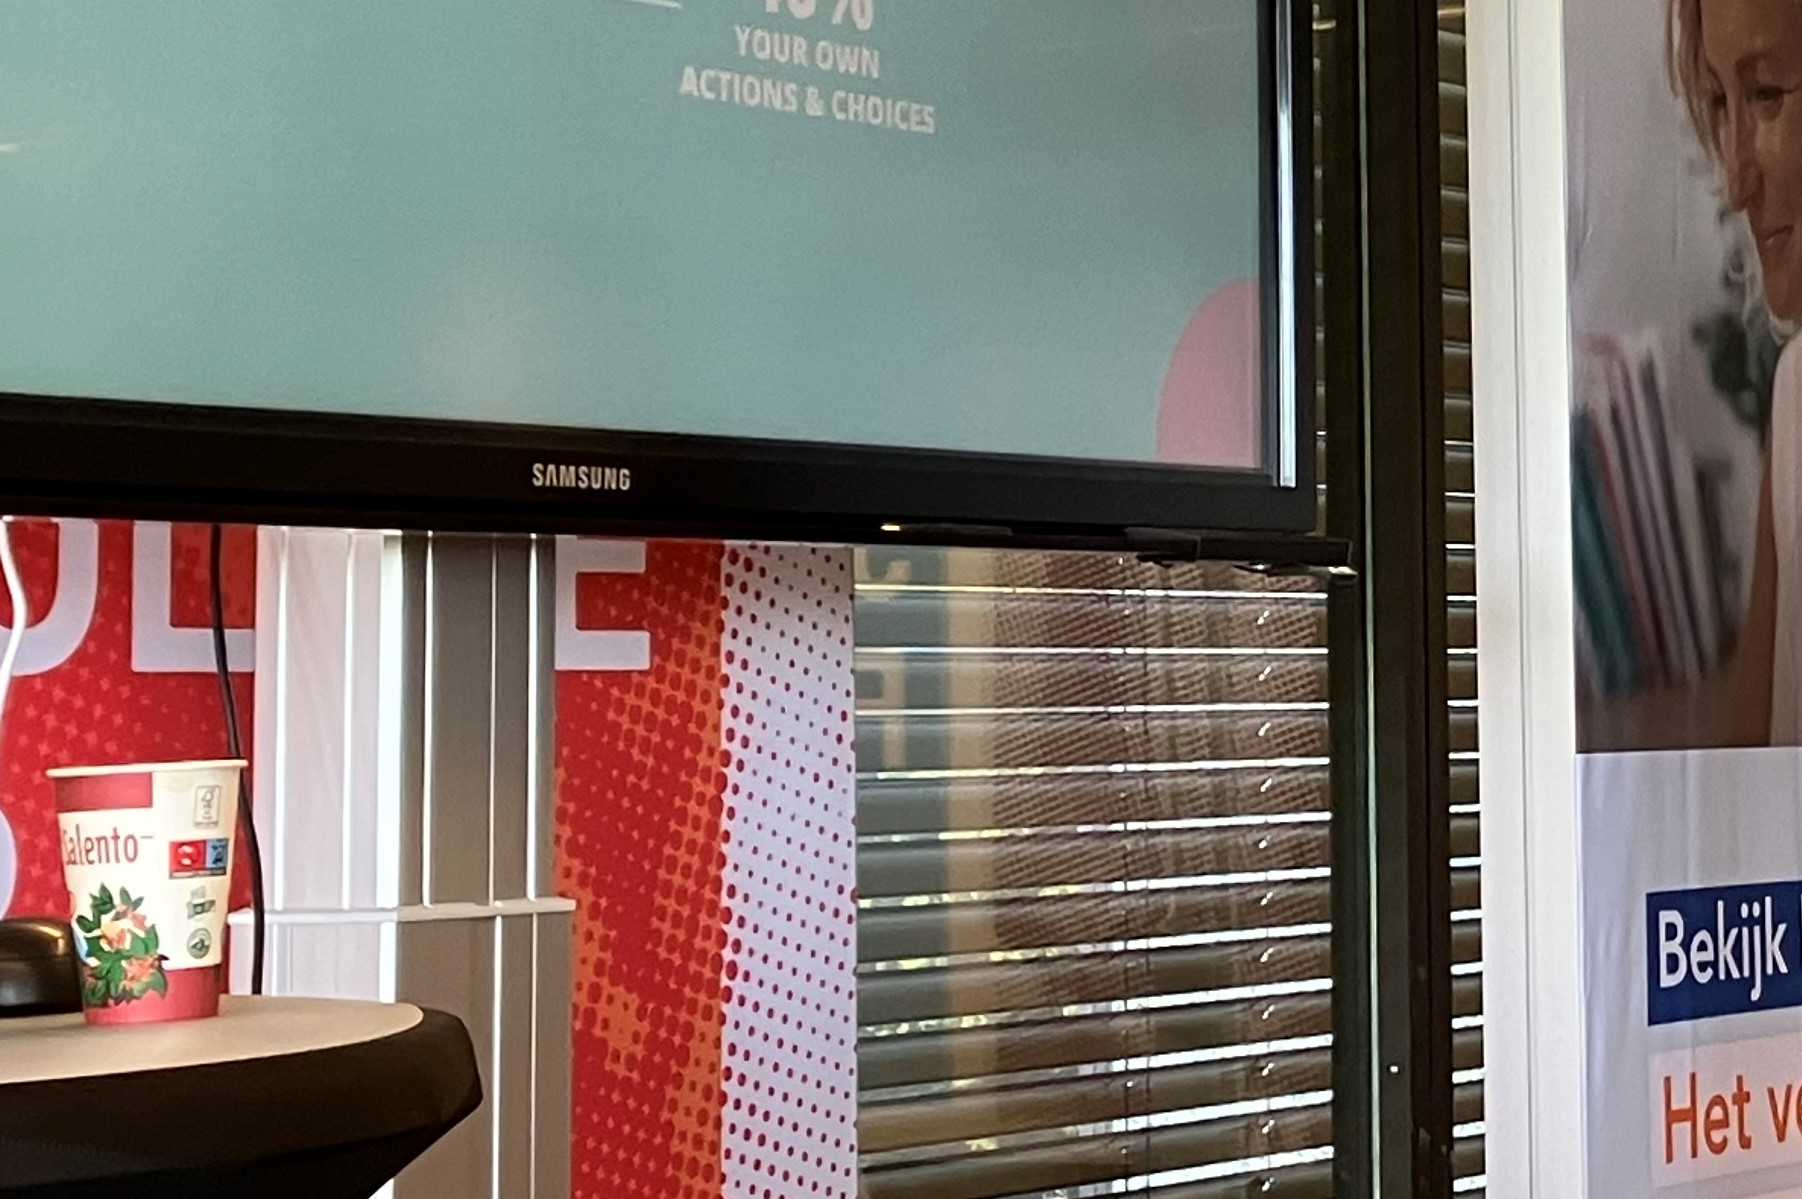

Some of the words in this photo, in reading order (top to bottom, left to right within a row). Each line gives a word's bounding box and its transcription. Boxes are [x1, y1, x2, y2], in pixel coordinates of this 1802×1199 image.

[734, 24, 808, 67] YOUR
[815, 40, 880, 79] OWN
[680, 65, 798, 113] ACTIONS
[804, 85, 824, 116] &
[832, 89, 935, 134] CHOICES
[532, 462, 631, 491] SAMSUNG
[1658, 895, 1788, 1002] Bekijk
[1663, 1071, 1752, 1165] Het
